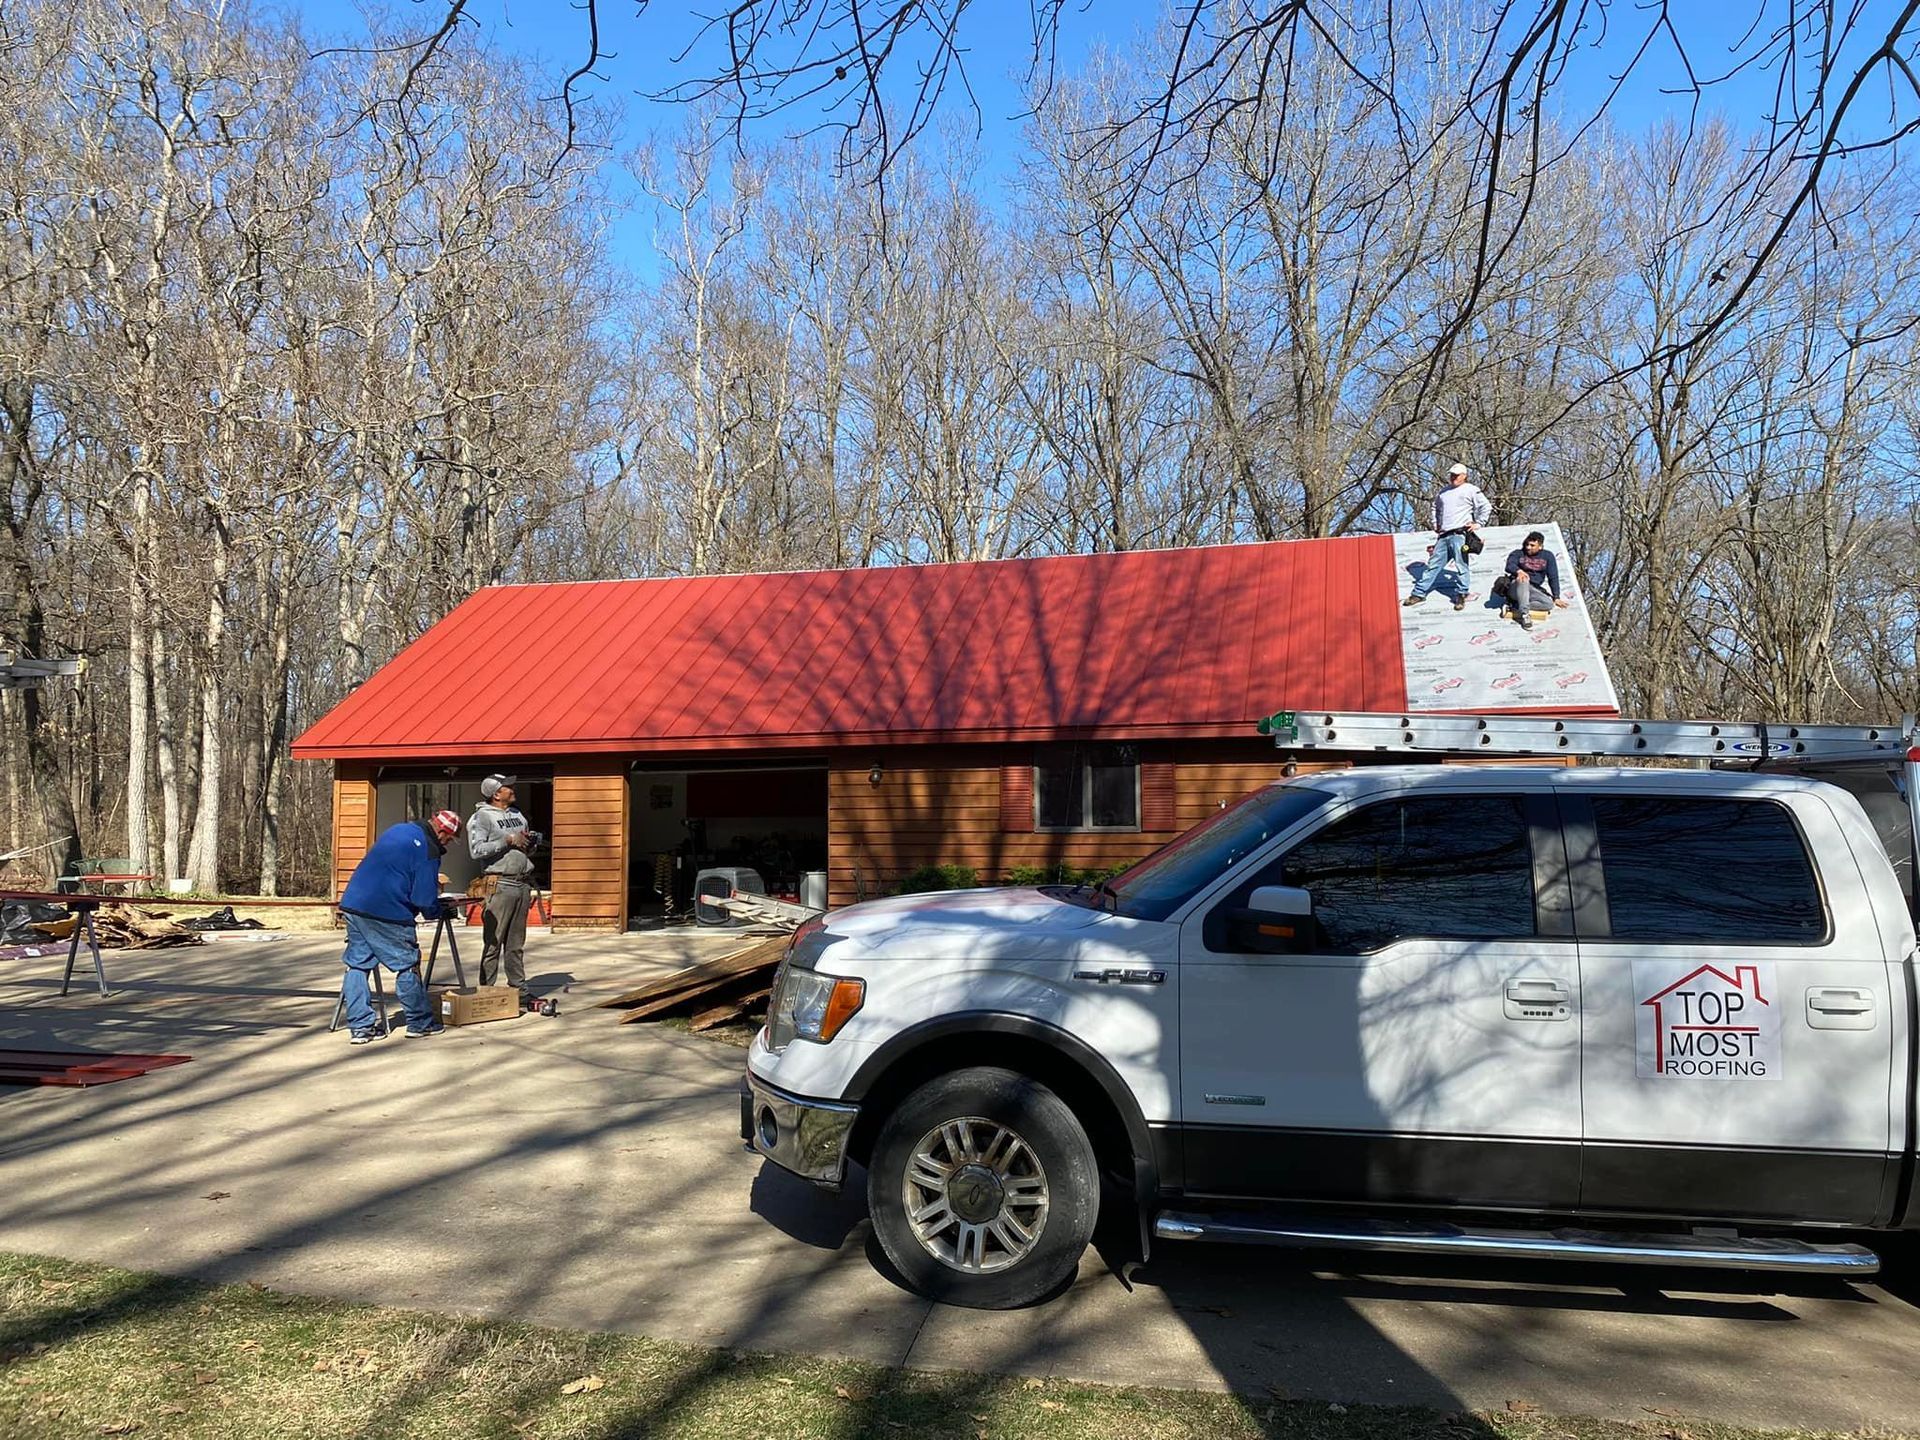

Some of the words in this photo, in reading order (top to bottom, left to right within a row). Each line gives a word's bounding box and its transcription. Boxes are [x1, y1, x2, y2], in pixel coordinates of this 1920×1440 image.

[1676, 991, 1744, 1025] TOP
[1670, 1032, 1760, 1057] MOST
[1666, 1060, 1766, 1076] ROOFING
